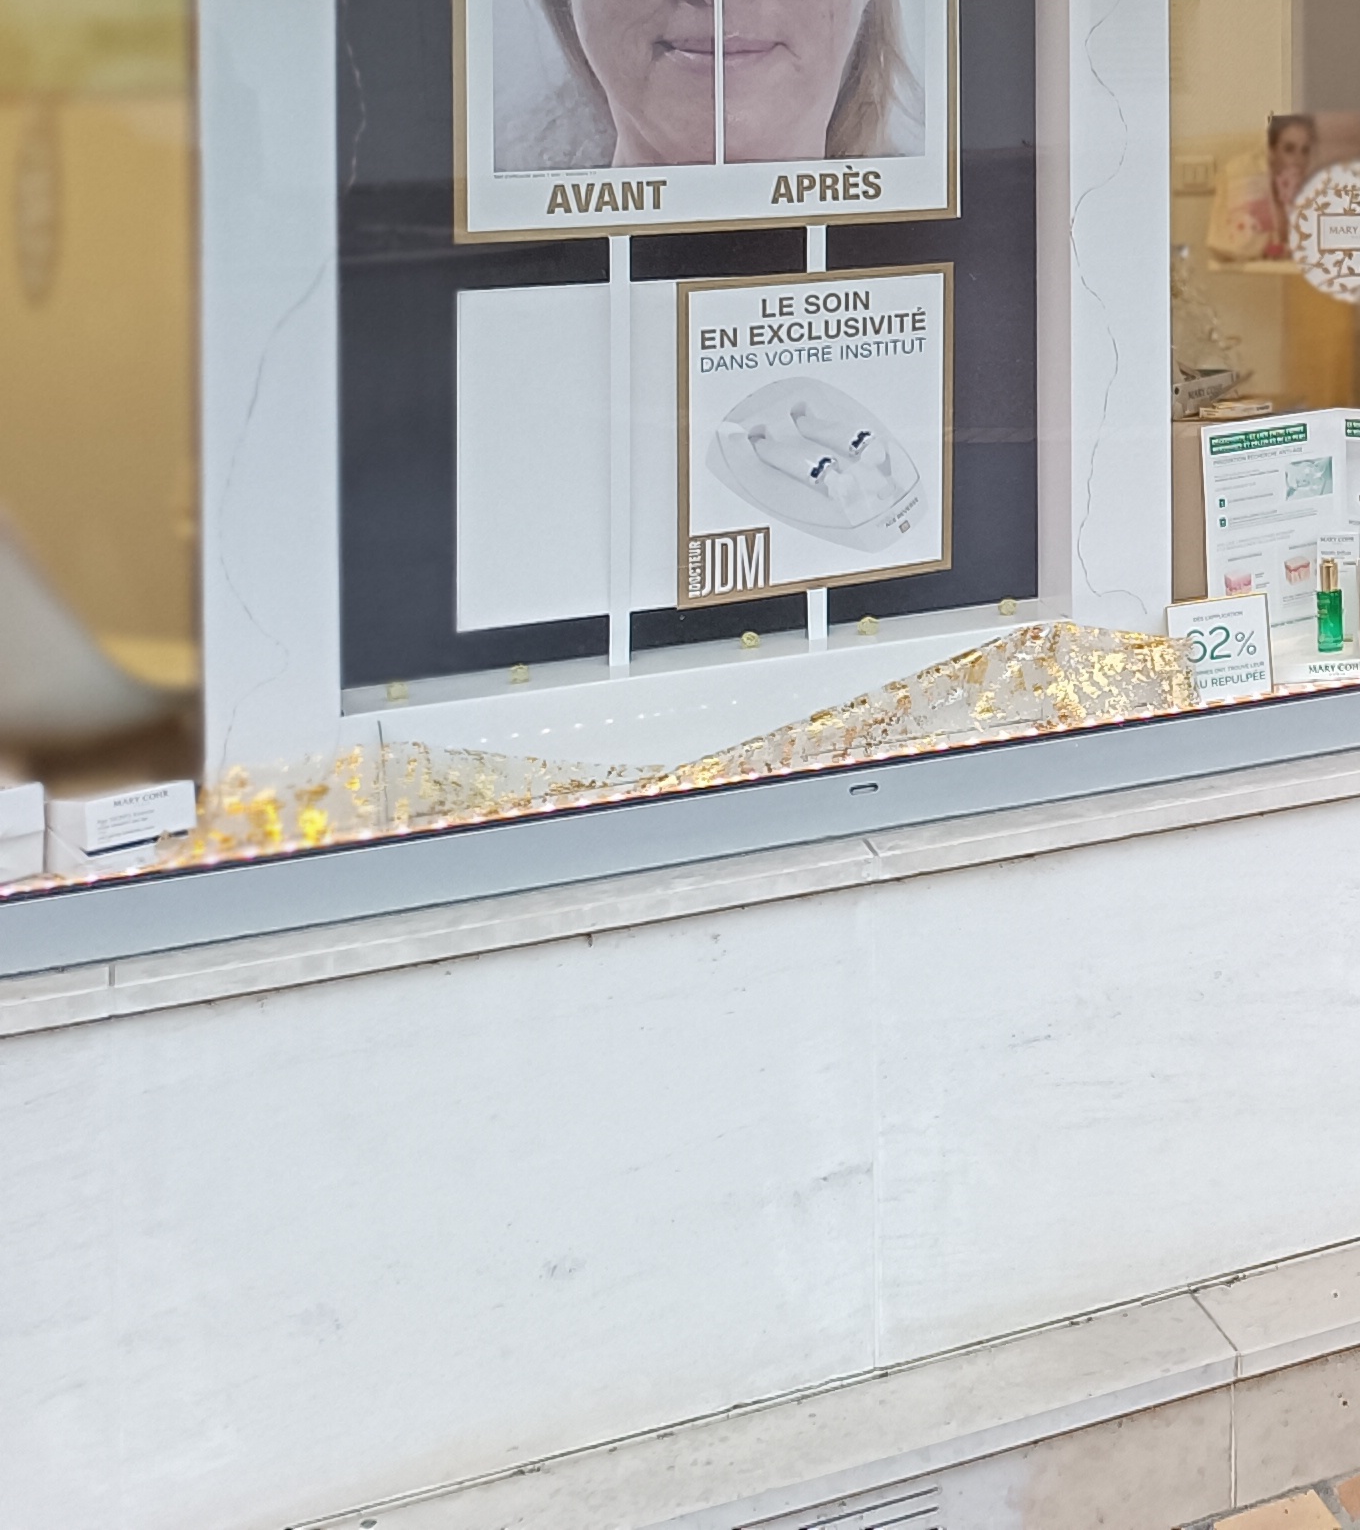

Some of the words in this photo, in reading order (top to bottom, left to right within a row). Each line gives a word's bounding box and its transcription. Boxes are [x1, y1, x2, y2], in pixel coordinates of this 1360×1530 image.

[546, 179, 668, 215] AVANT
[770, 165, 883, 205] APRÈS
[1329, 226, 1358, 235] MARY
[761, 296, 795, 319] LE
[804, 290, 870, 315] SOIN
[700, 327, 738, 351] EN
[749, 307, 927, 347] EXCLUSIVITÉ
[700, 352, 759, 373] DANS
[764, 345, 833, 367] VOTRE
[840, 337, 927, 361] INSTITUT
[701, 532, 765, 598] JDM
[1211, 669, 1266, 688] REPULPÉE
[1308, 664, 1336, 675] MARY
[113, 796, 141, 808] MARY
[142, 790, 169, 802] COHR
